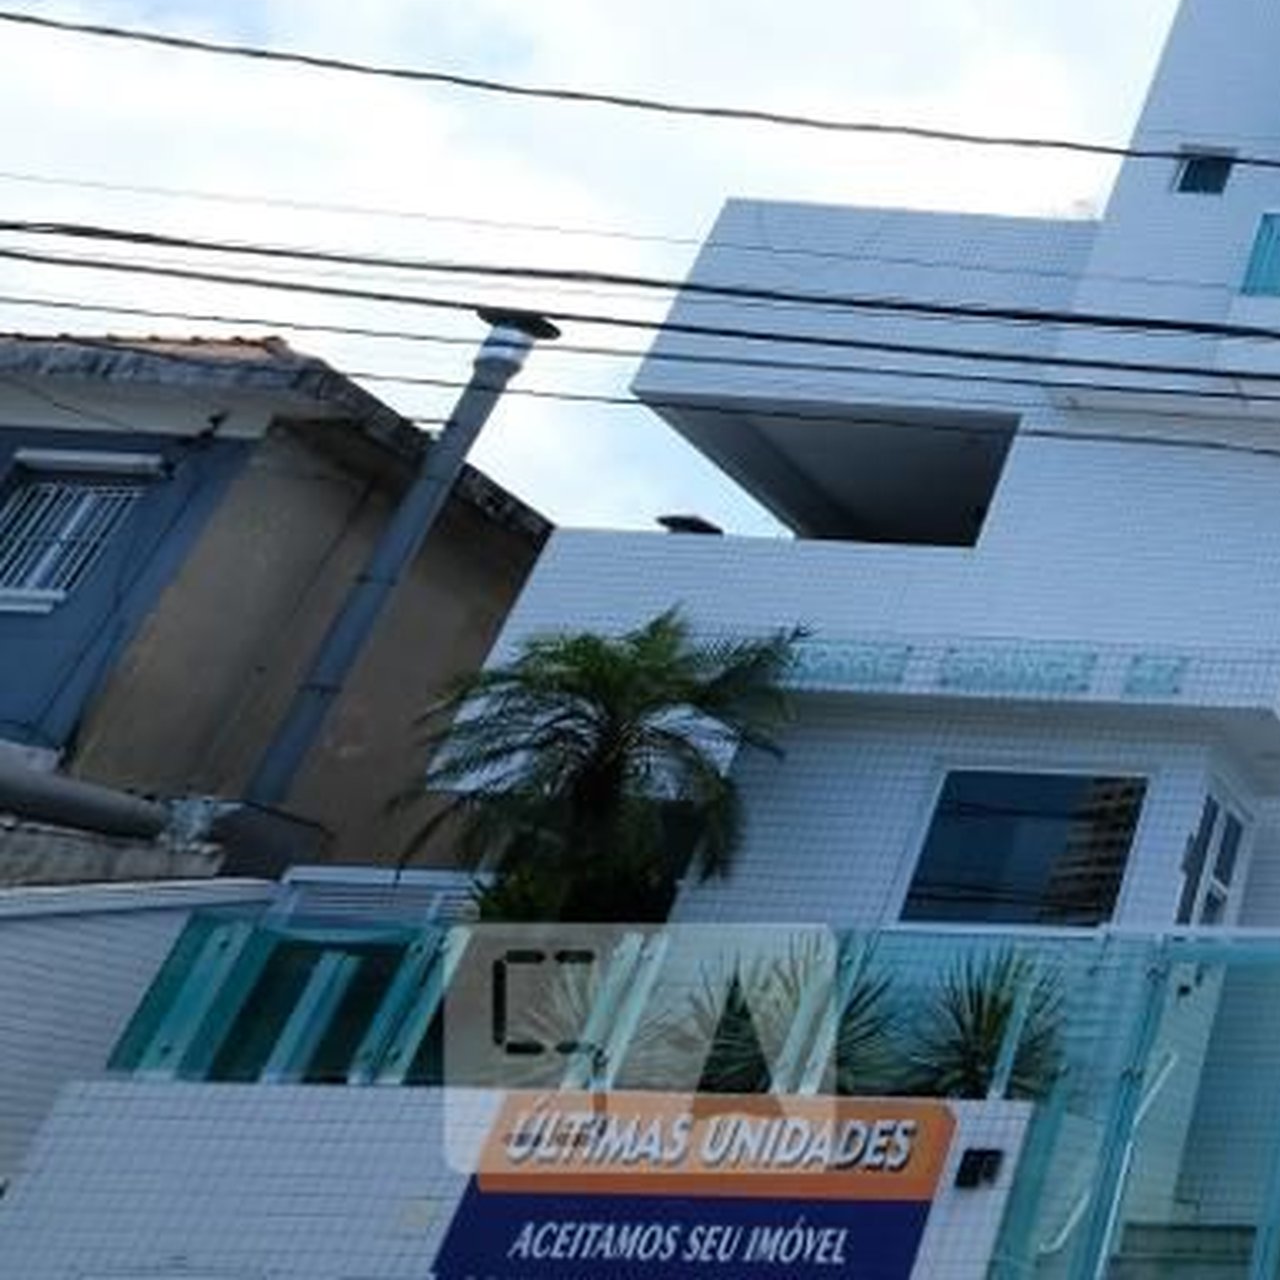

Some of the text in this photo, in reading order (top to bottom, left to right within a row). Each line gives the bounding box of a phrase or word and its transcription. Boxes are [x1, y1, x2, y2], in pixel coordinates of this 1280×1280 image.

[507, 1094, 917, 1172] ÚLTIMAS UNIDADES
[507, 1214, 849, 1263] ACEITAMOS SEU IMÓVEL
